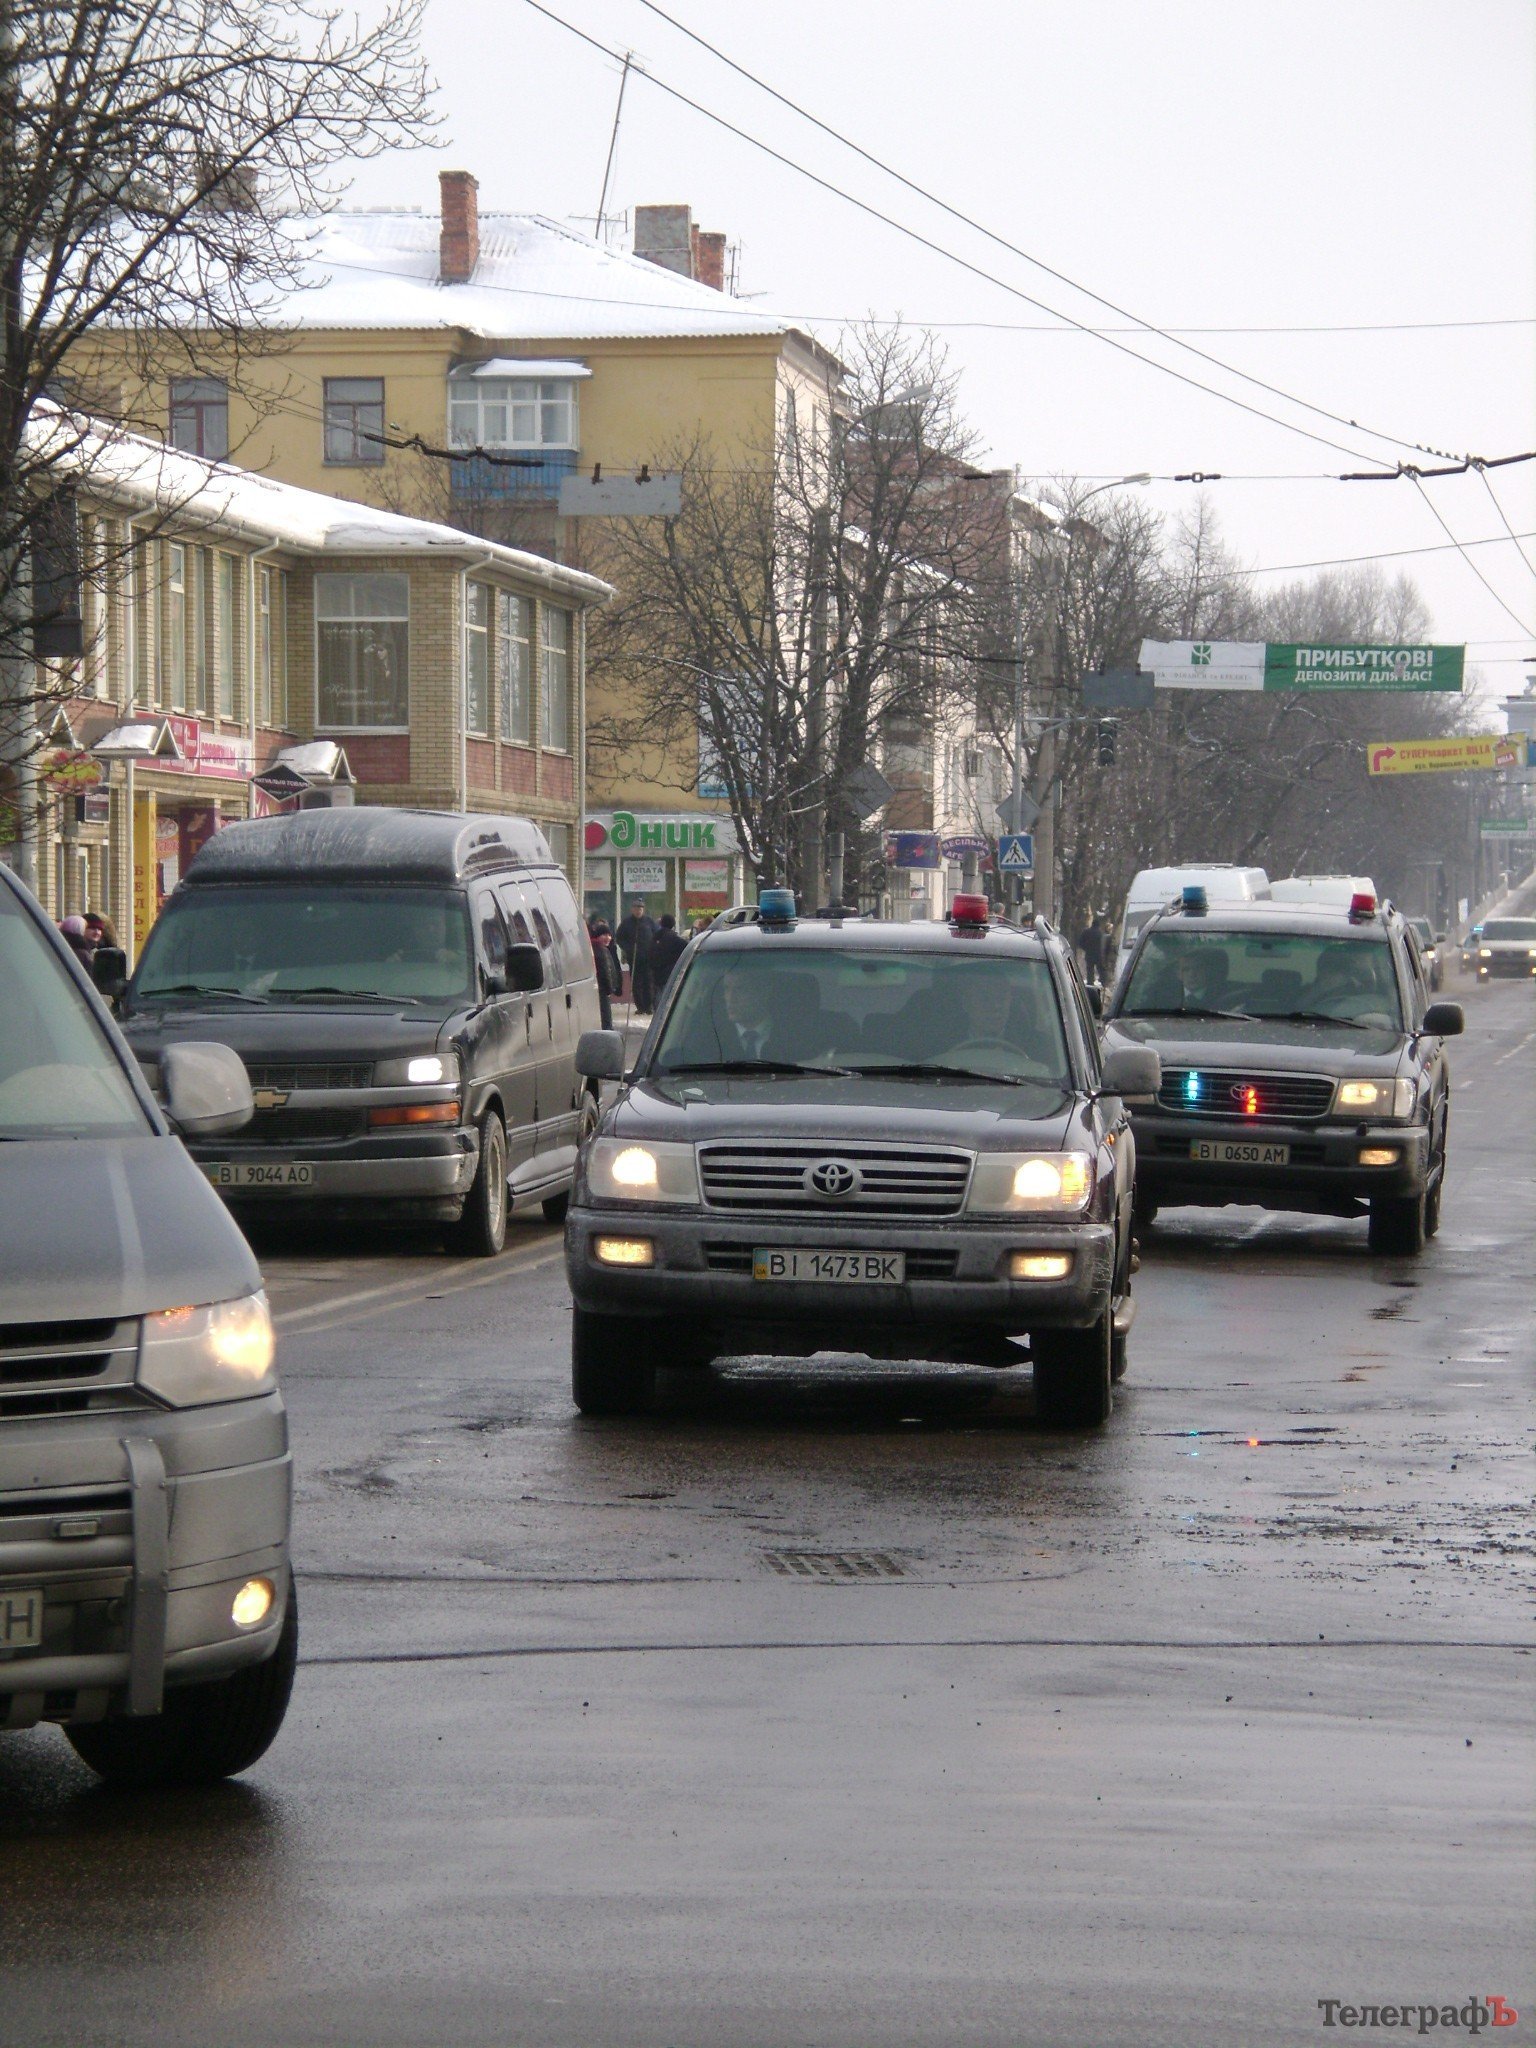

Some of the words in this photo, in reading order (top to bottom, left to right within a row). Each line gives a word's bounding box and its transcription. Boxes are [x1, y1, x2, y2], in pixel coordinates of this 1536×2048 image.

[1295, 671, 1366, 682] ДЕПОЗИТИ
[1369, 671, 1398, 683] ДЛЯ
[1402, 670, 1432, 682] ВАС!
[1200, 1145, 1217, 1158] BI
[1225, 1146, 1259, 1160] 0650
[1264, 1148, 1284, 1162] AM
[220, 1167, 239, 1183] BI
[247, 1167, 282, 1183] 9044
[770, 1254, 797, 1276] BI
[810, 1255, 860, 1278] 1473
[865, 1257, 897, 1280] BK
[0, 1598, 34, 1640] H
